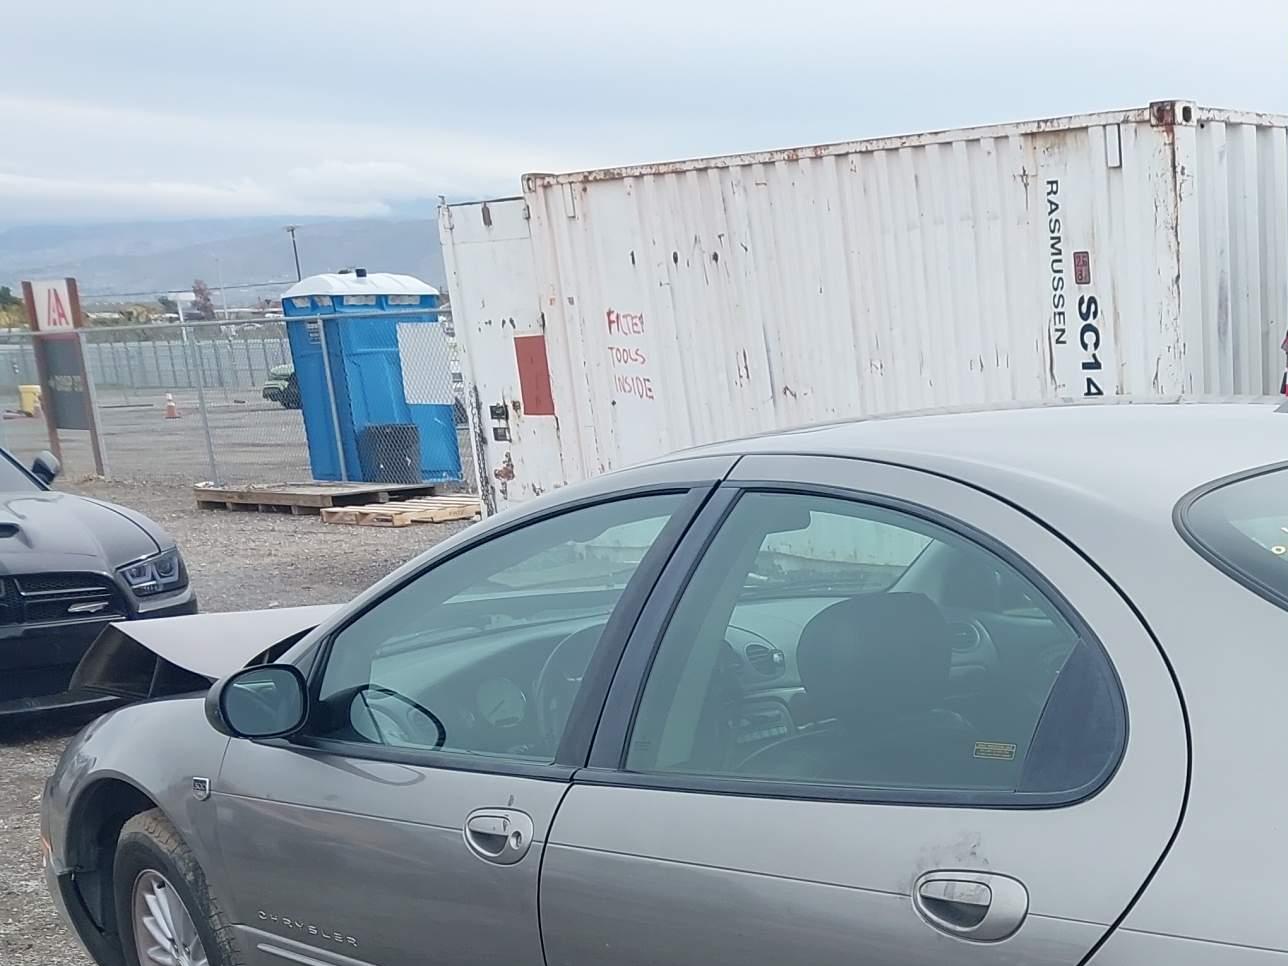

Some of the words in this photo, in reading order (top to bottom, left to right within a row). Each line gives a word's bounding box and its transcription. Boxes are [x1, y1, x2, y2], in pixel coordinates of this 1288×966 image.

[1046, 179, 1067, 345] RASMUSSEN
[607, 346, 646, 368] TOOLS
[1077, 294, 1105, 397] SC14
[614, 374, 655, 400] INSIDE
[258, 910, 358, 947] CHRYSLER
